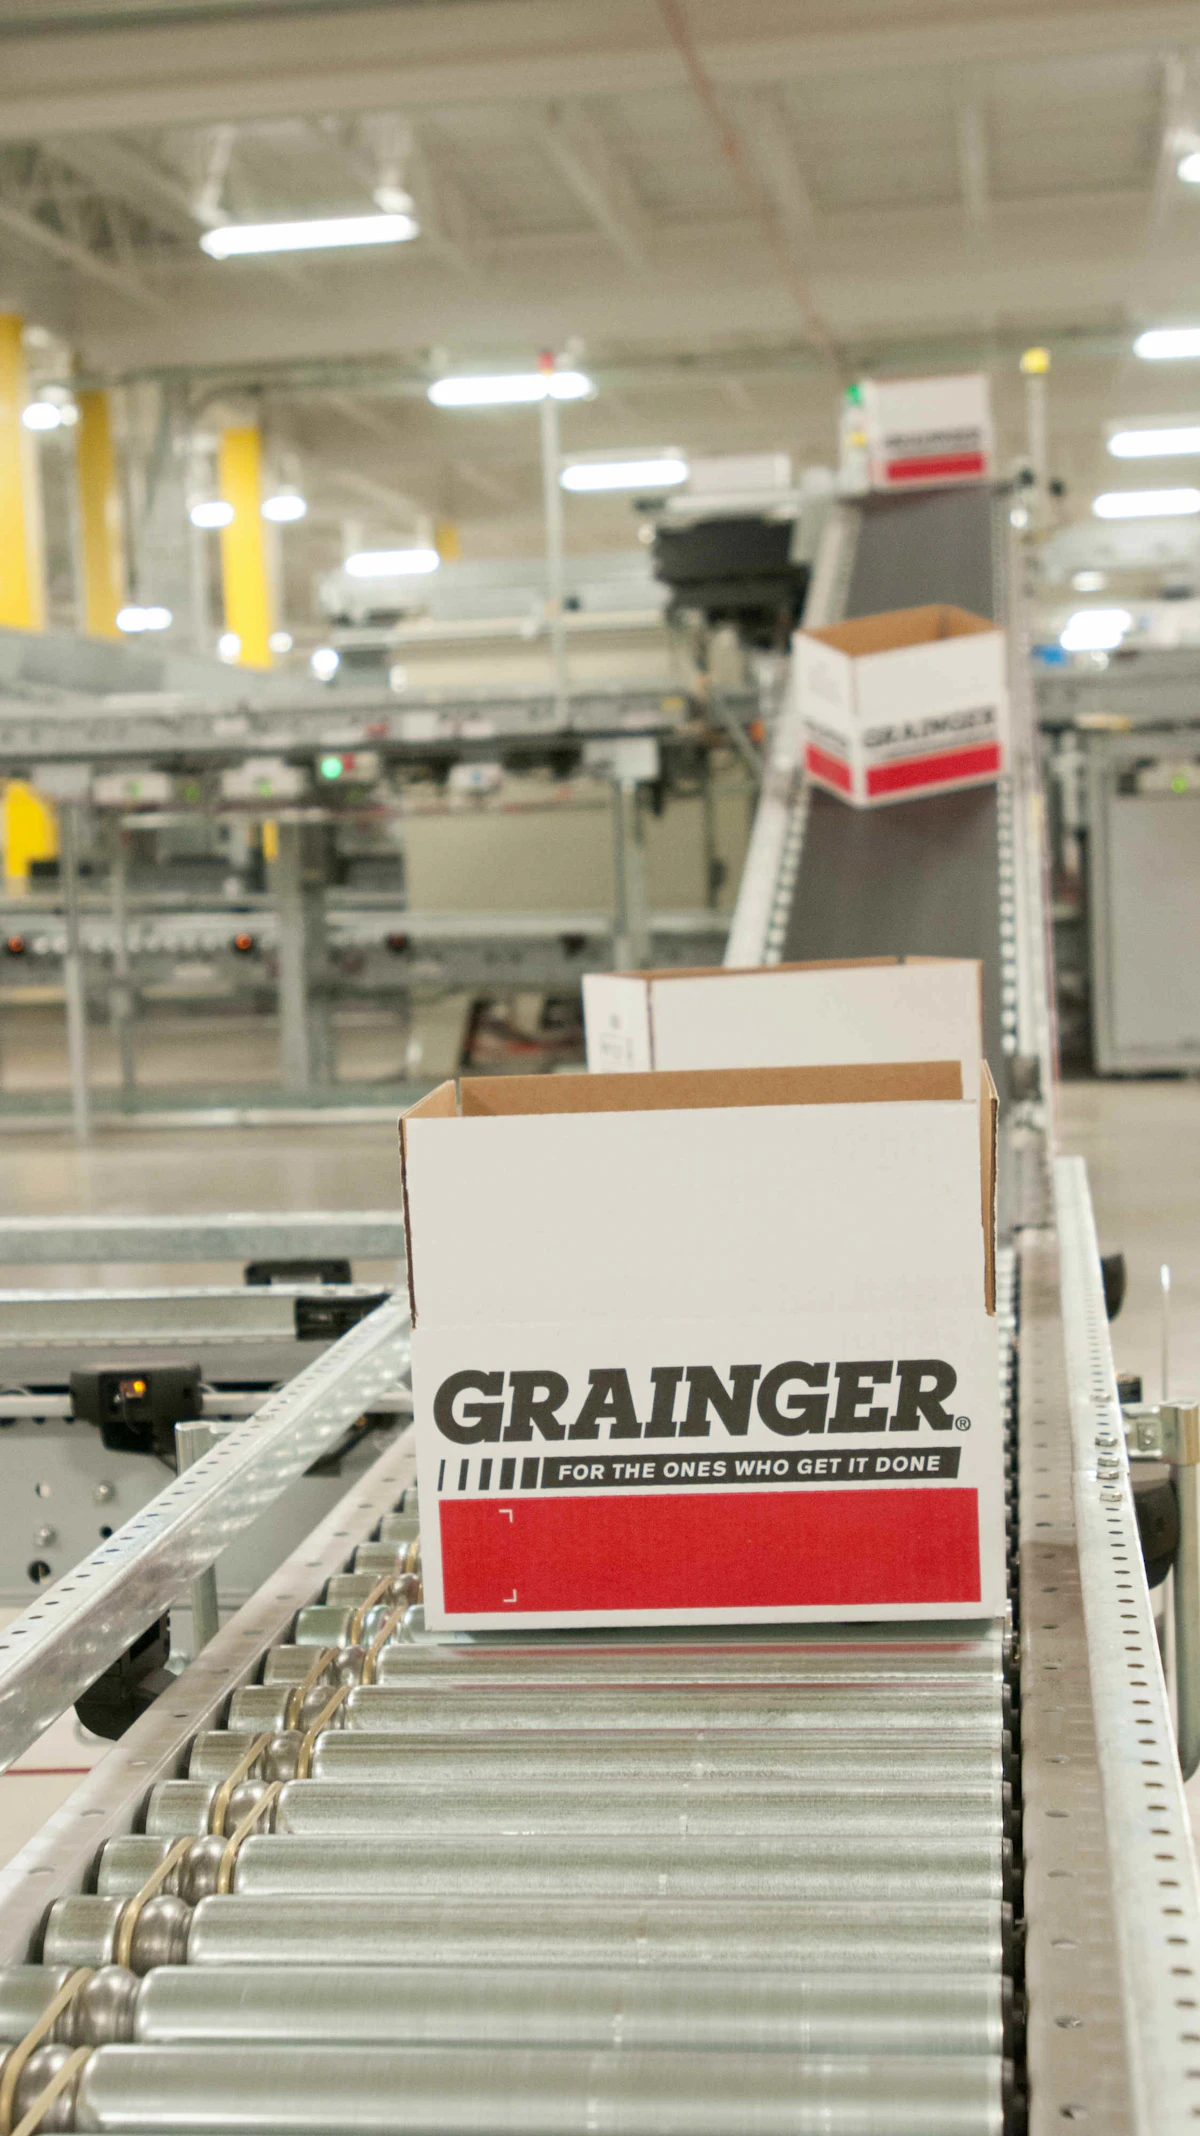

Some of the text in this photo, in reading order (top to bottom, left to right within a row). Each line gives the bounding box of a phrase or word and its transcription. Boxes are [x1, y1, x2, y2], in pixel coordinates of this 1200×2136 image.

[558, 1455, 941, 1481] FOR THE ONES WHO GET IT DONE
